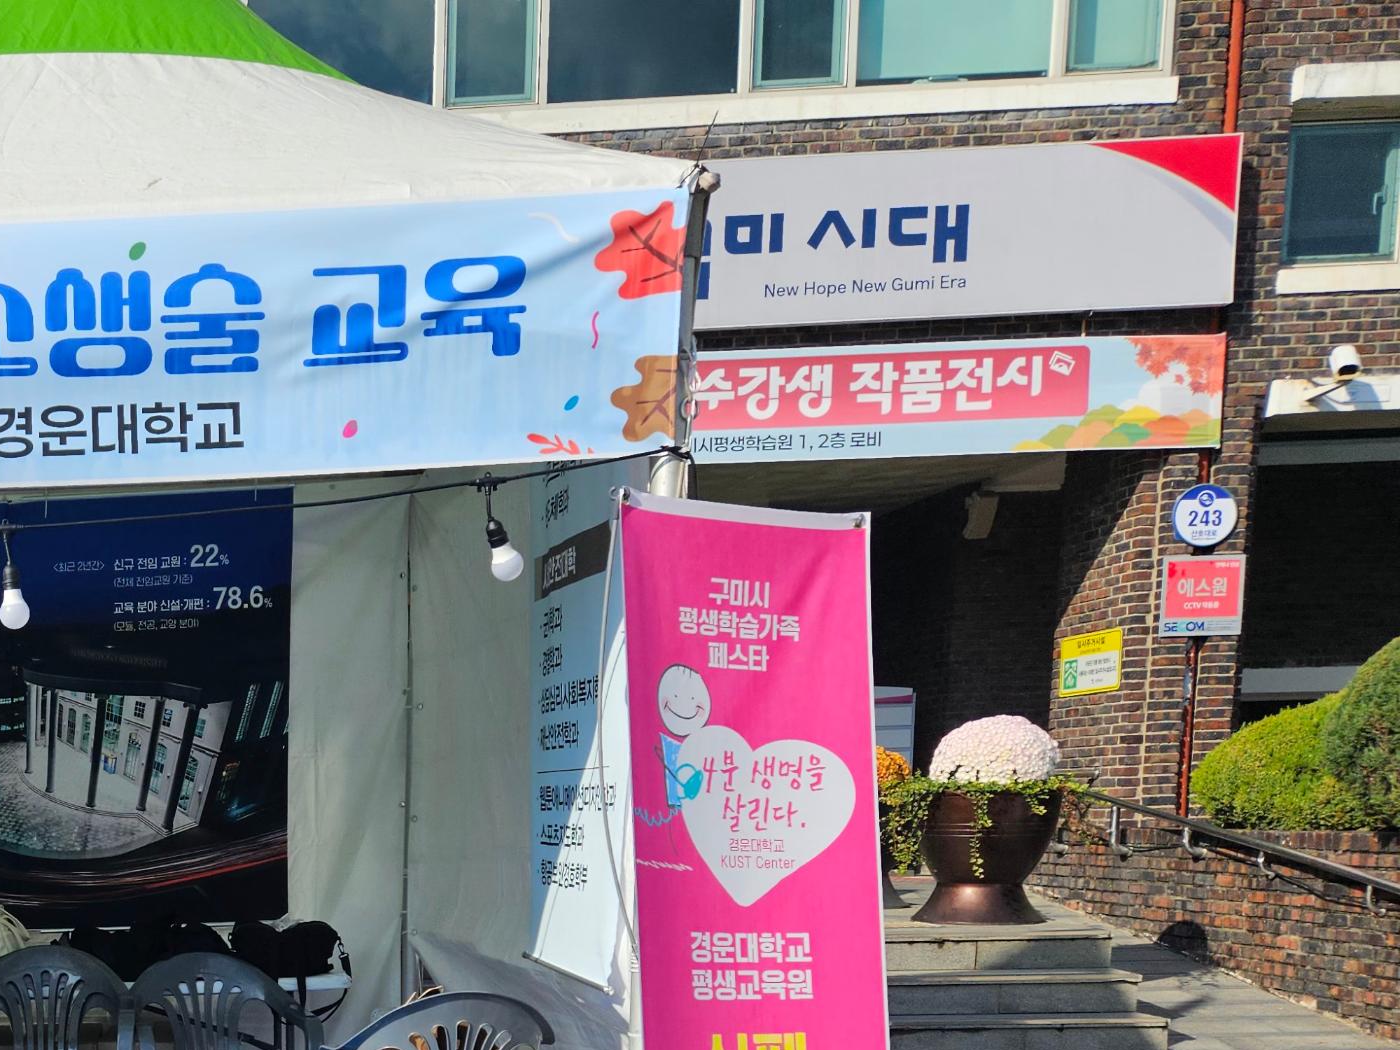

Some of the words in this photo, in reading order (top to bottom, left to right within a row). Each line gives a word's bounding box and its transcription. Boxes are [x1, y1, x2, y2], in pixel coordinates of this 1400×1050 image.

[806, 204, 970, 263] 시대
[764, 283, 799, 298] New
[804, 281, 847, 300] Hope
[851, 279, 886, 294] New
[891, 276, 935, 292] Gumi
[940, 275, 967, 290] Era
[303, 256, 526, 368] 교육
[694, 363, 834, 421] 수강생
[850, 353, 1042, 415] 작품전시
[818, 432, 846, 449] 2층
[850, 431, 882, 448] 로비
[1188, 510, 1222, 527] 243
[113, 559, 135, 571] 신규
[137, 557, 158, 570] 전임
[160, 556, 181, 568] 교원
[190, 543, 230, 568] 22%
[136, 575, 171, 588] 전임교원
[708, 577, 771, 608] 구미시
[1177, 577, 1228, 598] 에스원
[113, 602, 135, 614] 교육
[136, 600, 158, 613] 분야
[212, 585, 273, 610] 78.6%
[678, 605, 801, 642] 평생학습가족
[707, 641, 770, 672] 페스타
[702, 750, 740, 794] 4분
[751, 754, 827, 792] 생명을
[722, 793, 807, 833] 살린다.
[729, 837, 785, 853] 경운대학교
[721, 856, 752, 869] KUST
[756, 856, 796, 870] Center
[690, 931, 813, 964] 경운대학교
[691, 968, 814, 1001] 평생교육원
